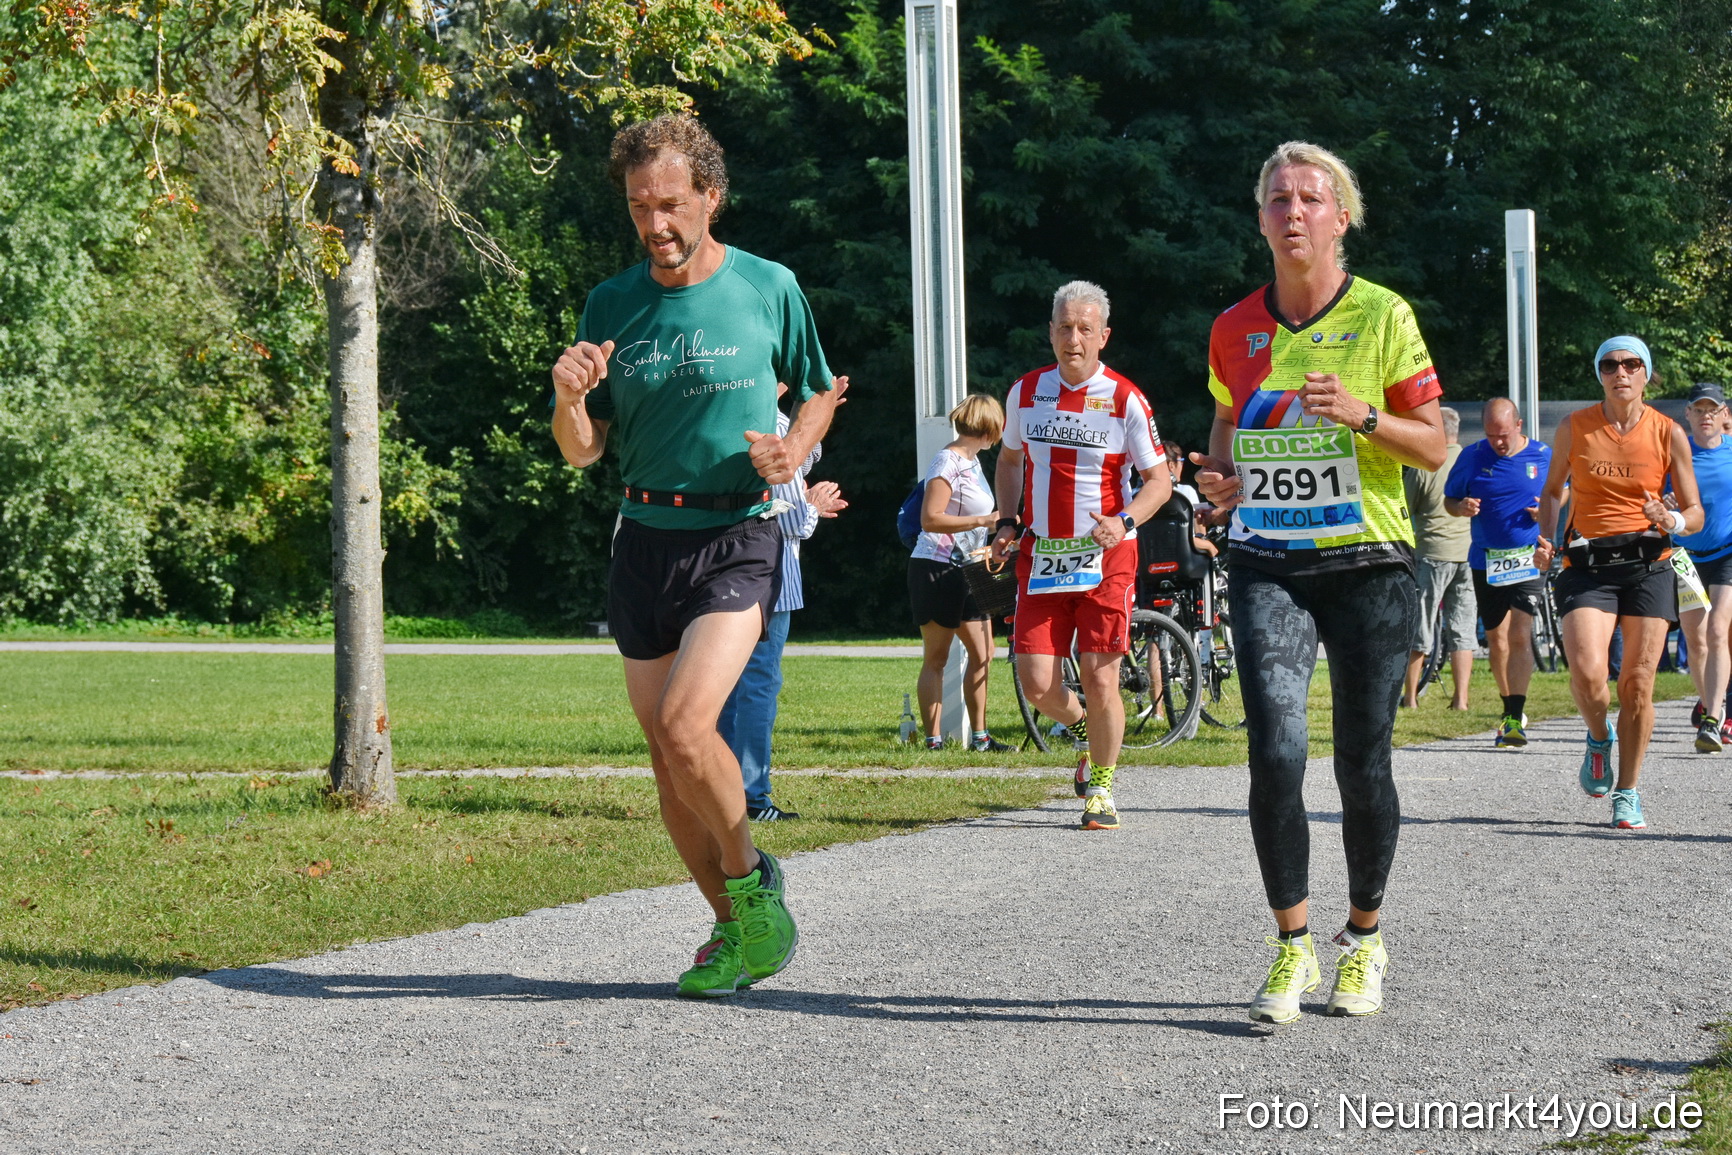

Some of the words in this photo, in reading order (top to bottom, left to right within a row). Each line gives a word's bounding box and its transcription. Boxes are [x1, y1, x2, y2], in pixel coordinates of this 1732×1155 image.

[616, 339, 672, 377] Sandra
[672, 328, 741, 367] Lehmeier
[644, 366, 715, 382] FRISEURE
[682, 378, 756, 398] LAUTERHOFEN
[1031, 394, 1060, 403] macron
[1026, 423, 1108, 445] LAYENBERGER
[1240, 431, 1344, 458] BOCK
[1249, 466, 1341, 501] 2691
[1039, 536, 1097, 552] BOCK
[1040, 553, 1095, 576] 2472
[1493, 557, 1531, 573] 2032
[1055, 575, 1075, 585] IVO
[1495, 570, 1531, 582] CLAUDIO
